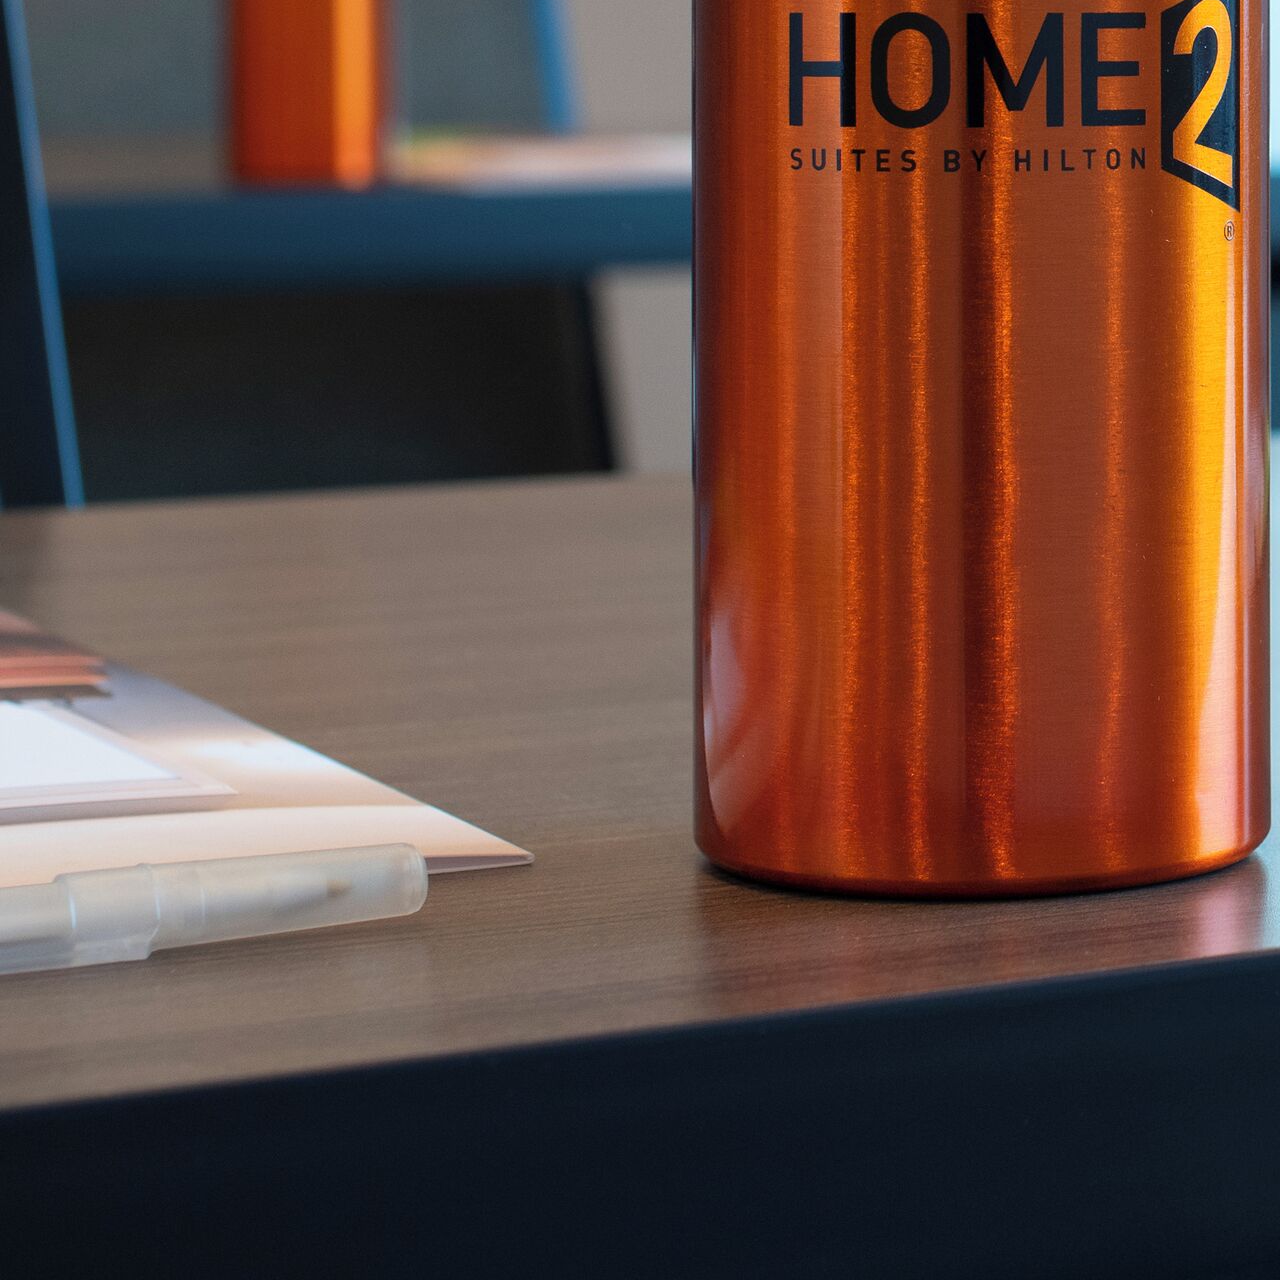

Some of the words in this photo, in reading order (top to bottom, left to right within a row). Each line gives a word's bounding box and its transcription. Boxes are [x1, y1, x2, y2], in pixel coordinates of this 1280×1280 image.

[790, 148, 917, 172] SUITES
[944, 149, 986, 172] BY
[1014, 147, 1147, 172] HILTON
